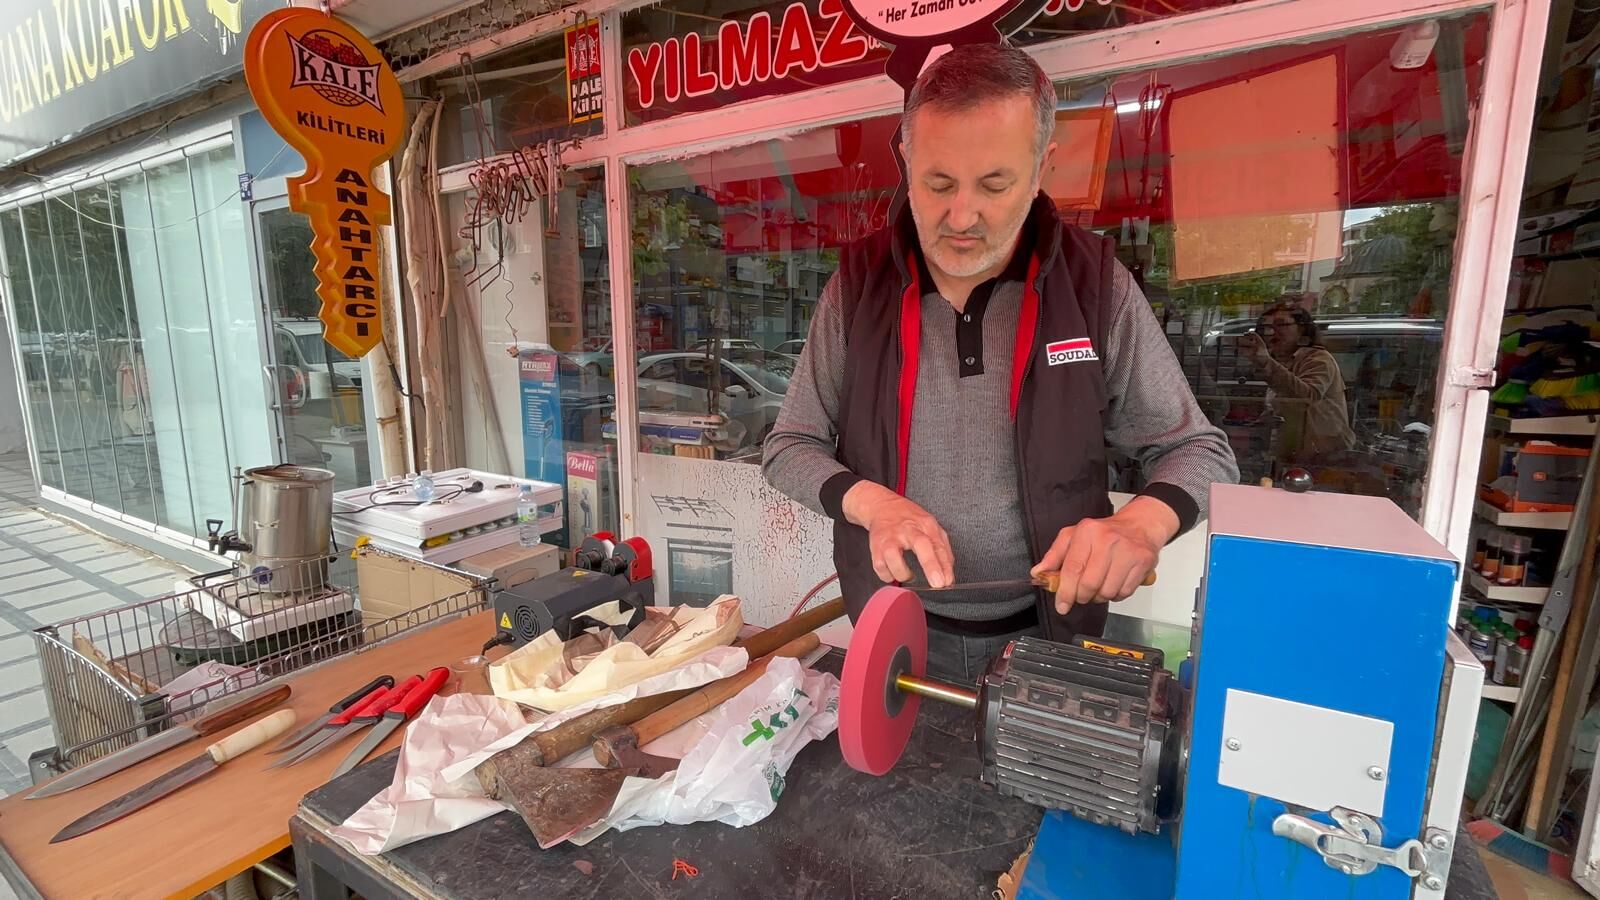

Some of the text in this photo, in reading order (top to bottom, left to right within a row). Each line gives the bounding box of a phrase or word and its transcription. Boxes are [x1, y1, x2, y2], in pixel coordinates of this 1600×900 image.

[910, 0, 954, 18] Zaman
[297, 49, 378, 102] KALE
[628, 0, 869, 108] YILMAZ
[296, 110, 386, 145] KİLİTLERİ
[334, 168, 378, 337] ANAHTARCI
[568, 456, 595, 473] Bella
